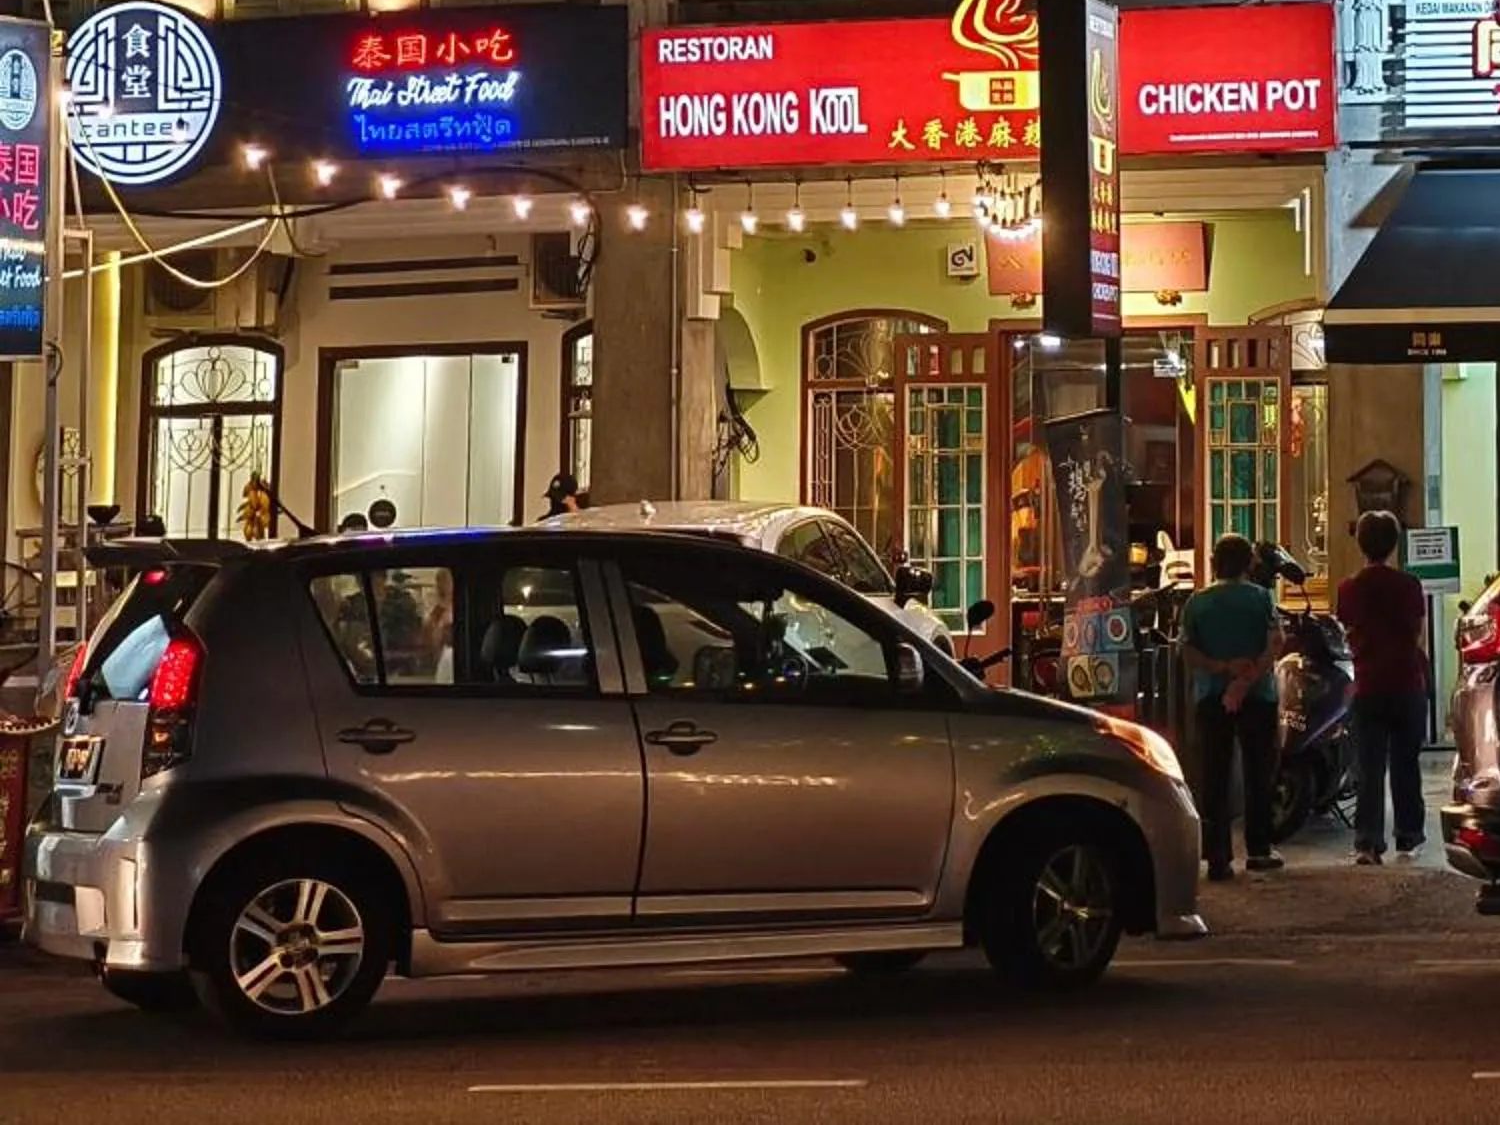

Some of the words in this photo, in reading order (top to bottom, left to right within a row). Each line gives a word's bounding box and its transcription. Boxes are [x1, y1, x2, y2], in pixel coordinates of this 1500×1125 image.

[121, 23, 152, 99] 食堂
[353, 29, 513, 69] 泰国小吃
[658, 35, 773, 63] RESTORAN
[347, 76, 394, 109] Thai
[397, 71, 463, 106] Street
[464, 71, 522, 104] Food
[1139, 81, 1259, 115] CHICKEN
[1266, 78, 1321, 112] POT
[659, 94, 727, 137] HONG
[732, 91, 799, 136] KONG
[809, 86, 869, 135] KOOL
